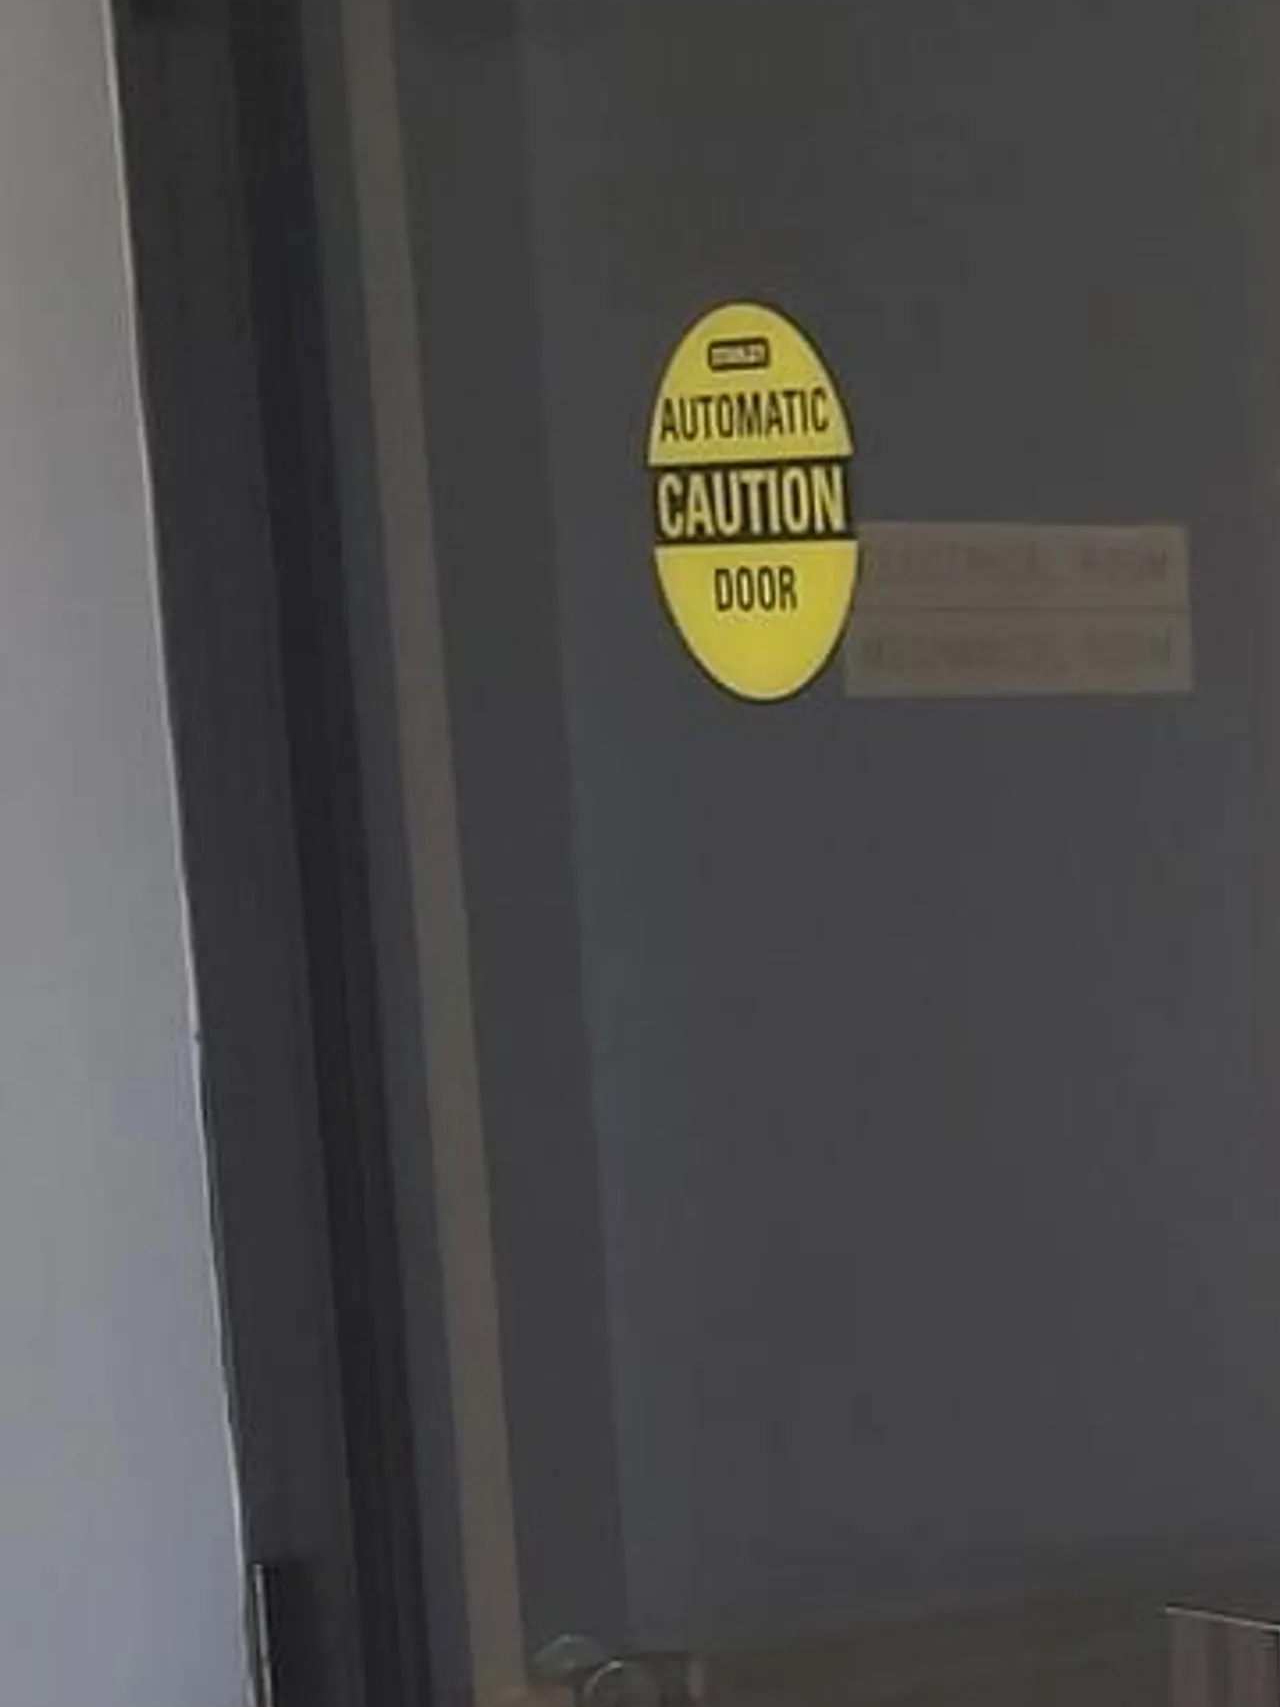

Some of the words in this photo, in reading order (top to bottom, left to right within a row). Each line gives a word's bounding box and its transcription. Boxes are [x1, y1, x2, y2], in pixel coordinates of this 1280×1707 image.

[660, 387, 830, 442] AUTOMATIC
[658, 466, 847, 539] CAUTION
[714, 566, 797, 612] DOOR
